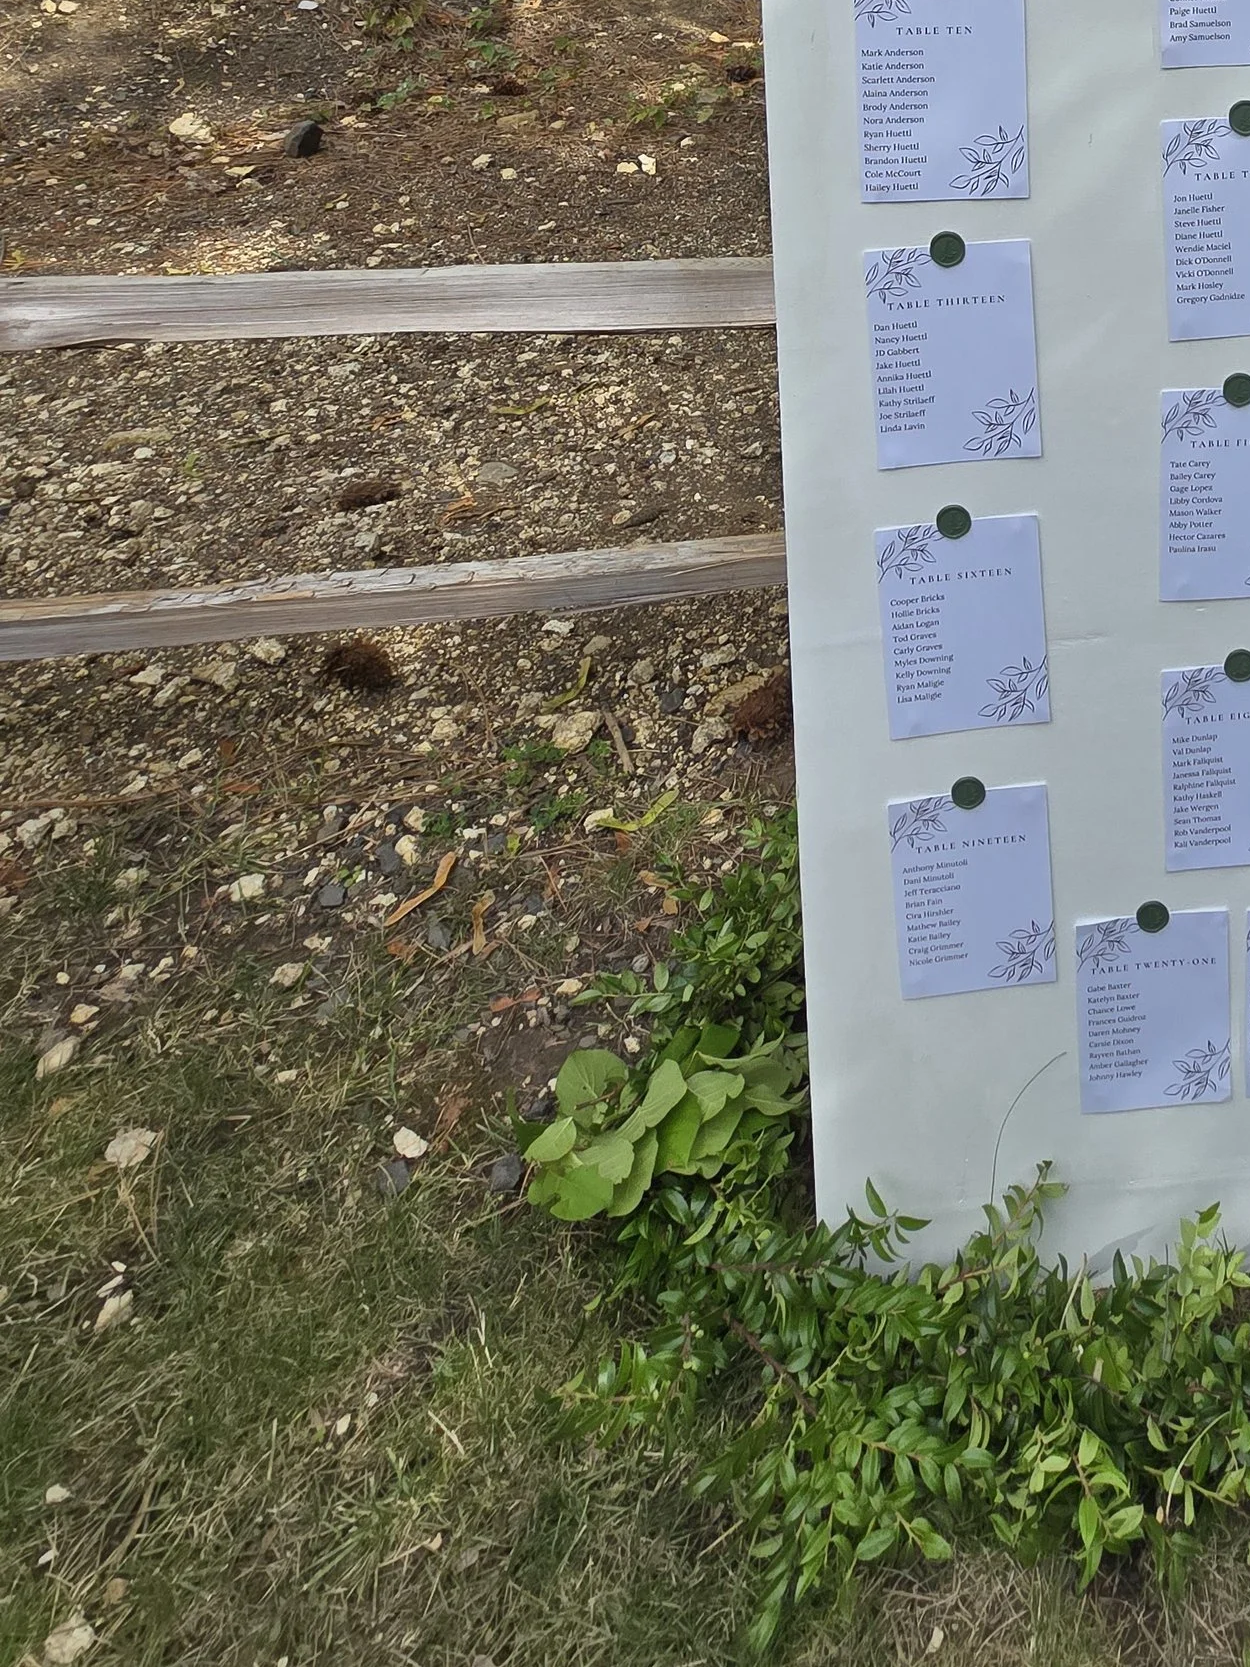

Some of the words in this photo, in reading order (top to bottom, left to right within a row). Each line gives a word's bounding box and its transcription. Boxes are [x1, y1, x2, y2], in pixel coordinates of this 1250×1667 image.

[1169, 20, 1188, 29] Brad
[1189, 19, 1231, 28] Samuelson
[895, 26, 940, 36] TABLE
[946, 26, 972, 35] TEN
[1169, 34, 1188, 44] Amy
[1188, 32, 1231, 42] Samuelson
[861, 48, 883, 57] Mark
[884, 48, 924, 57] Anderson
[864, 170, 884, 179] Cole
[885, 169, 921, 178] McCourt
[1194, 171, 1235, 181] TABLE
[1174, 220, 1196, 229] Steve
[1196, 217, 1222, 227] Huettl
[1175, 244, 1205, 254] Wendie
[1206, 242, 1231, 252] Maciel
[887, 299, 929, 311] TABLE
[936, 295, 1005, 307] THIRTEEN
[873, 324, 891, 332] Dan
[891, 320, 918, 331] Huettl
[880, 424, 902, 433] Linda
[904, 422, 925, 431] Lavin
[1190, 439, 1230, 449] TABLE
[1169, 461, 1187, 469] Tate
[1188, 460, 1211, 470] Carey
[1169, 509, 1195, 517] Mason
[1195, 508, 1222, 516] Walker
[909, 573, 951, 585] TABLE
[957, 568, 1012, 580] SIXTEEN
[891, 622, 915, 631] Aidan
[915, 620, 940, 629] Logan
[894, 655, 918, 669] Myles
[918, 654, 954, 665] Downing
[1185, 714, 1224, 725] TABLE
[1172, 736, 1190, 745] Mike
[1191, 733, 1218, 743] Dunlap
[1174, 829, 1189, 837] Rob
[1189, 824, 1231, 835] Vanderpool
[915, 842, 956, 854] TABLE
[962, 835, 1026, 848] NINETEEN
[903, 876, 922, 886] Dani
[908, 946, 929, 955] Craig
[1091, 964, 1128, 975] TABLE
